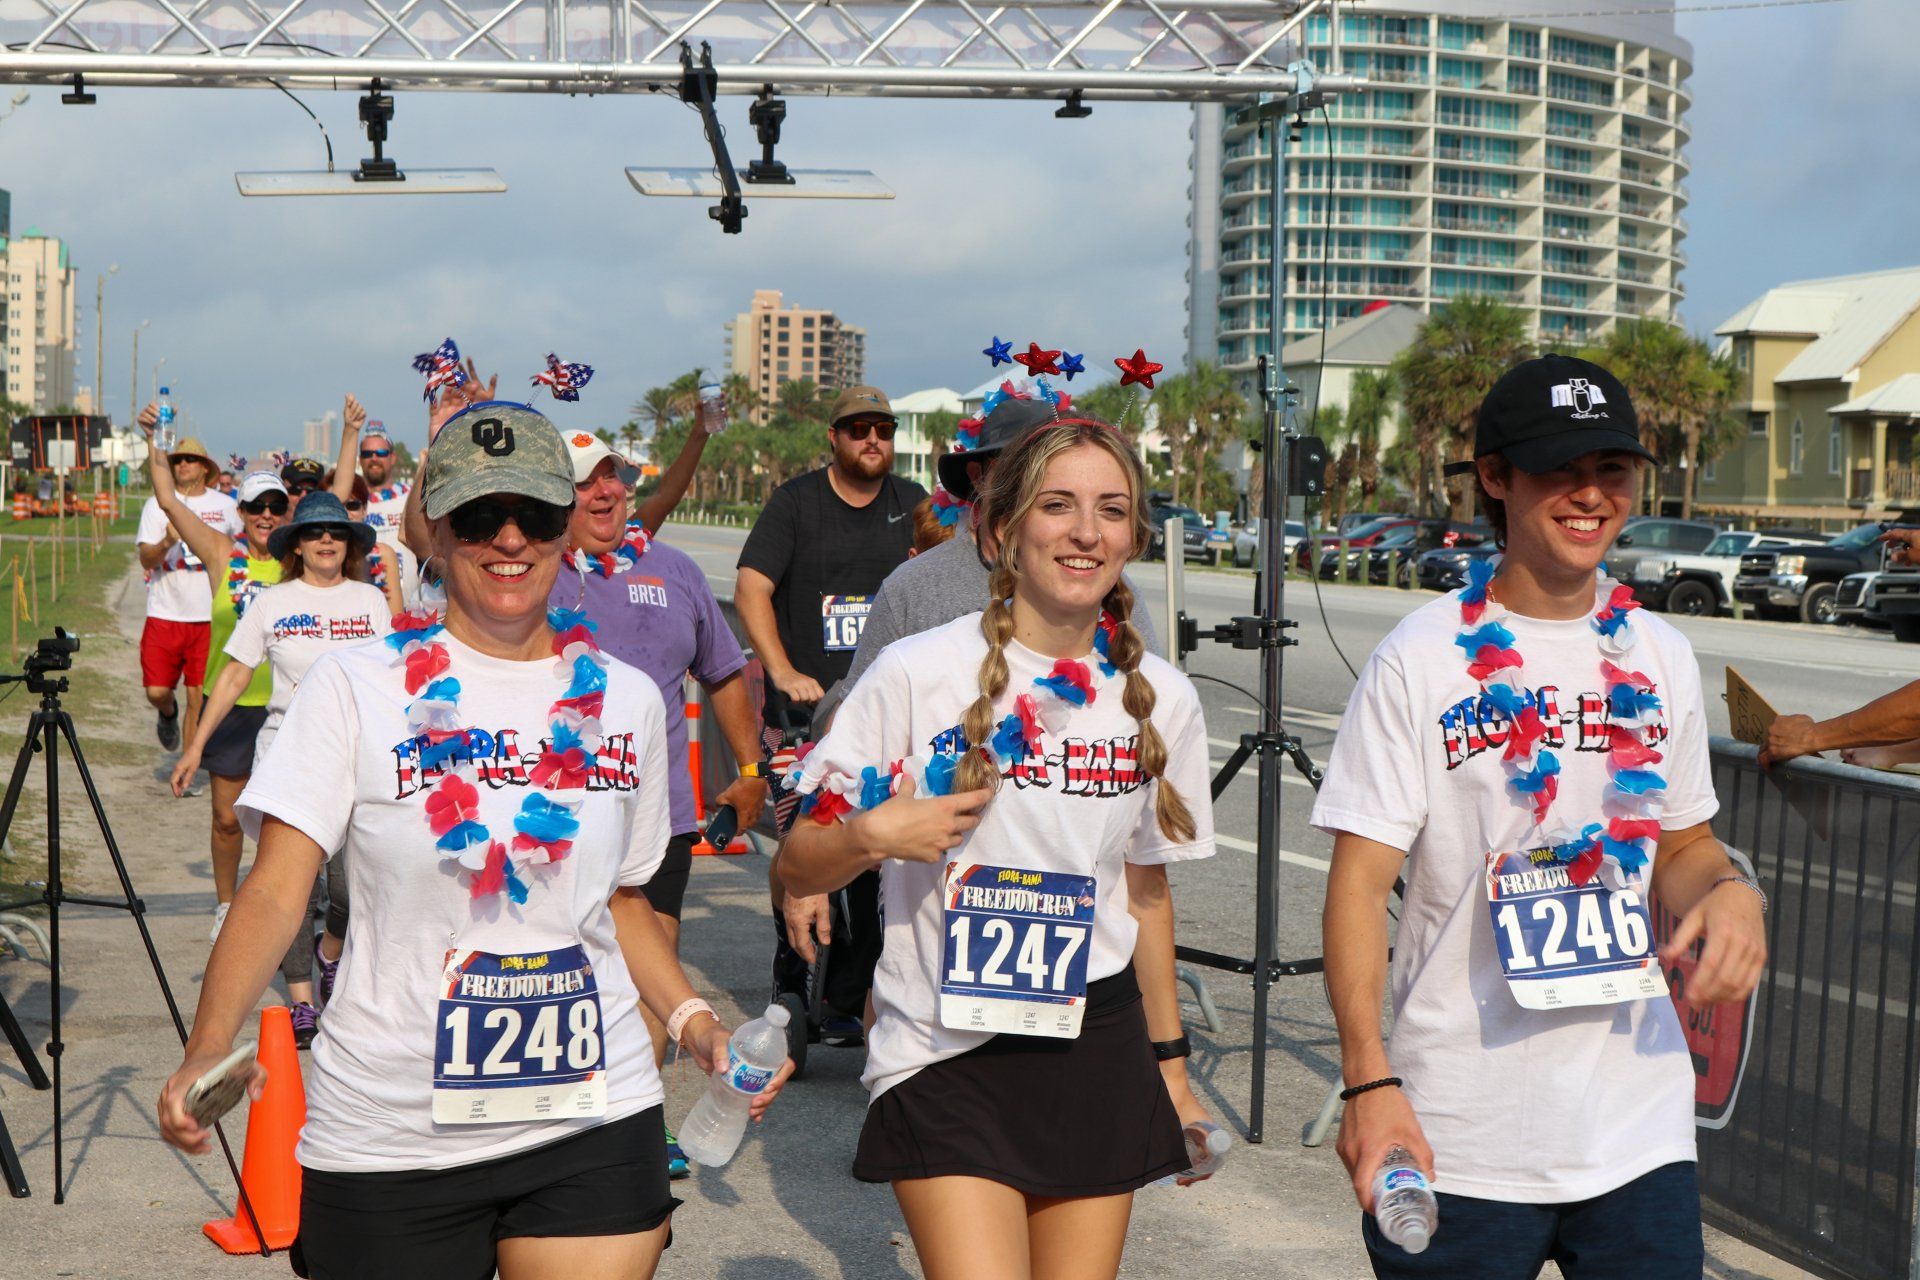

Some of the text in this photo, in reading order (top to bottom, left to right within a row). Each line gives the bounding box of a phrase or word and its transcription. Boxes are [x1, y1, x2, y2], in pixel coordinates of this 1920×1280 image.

[472, 418, 515, 457] OU
[628, 584, 667, 608] BRED
[998, 870, 1043, 886] FLORA-BAMA
[962, 886, 1077, 917] FREEDOM RUN
[1498, 889, 1650, 970] 1246
[501, 953, 549, 971] FLORA-BAMA
[948, 916, 1087, 991] 1247
[460, 968, 586, 999] FREEDOM RUN
[443, 999, 601, 1076] 1248
